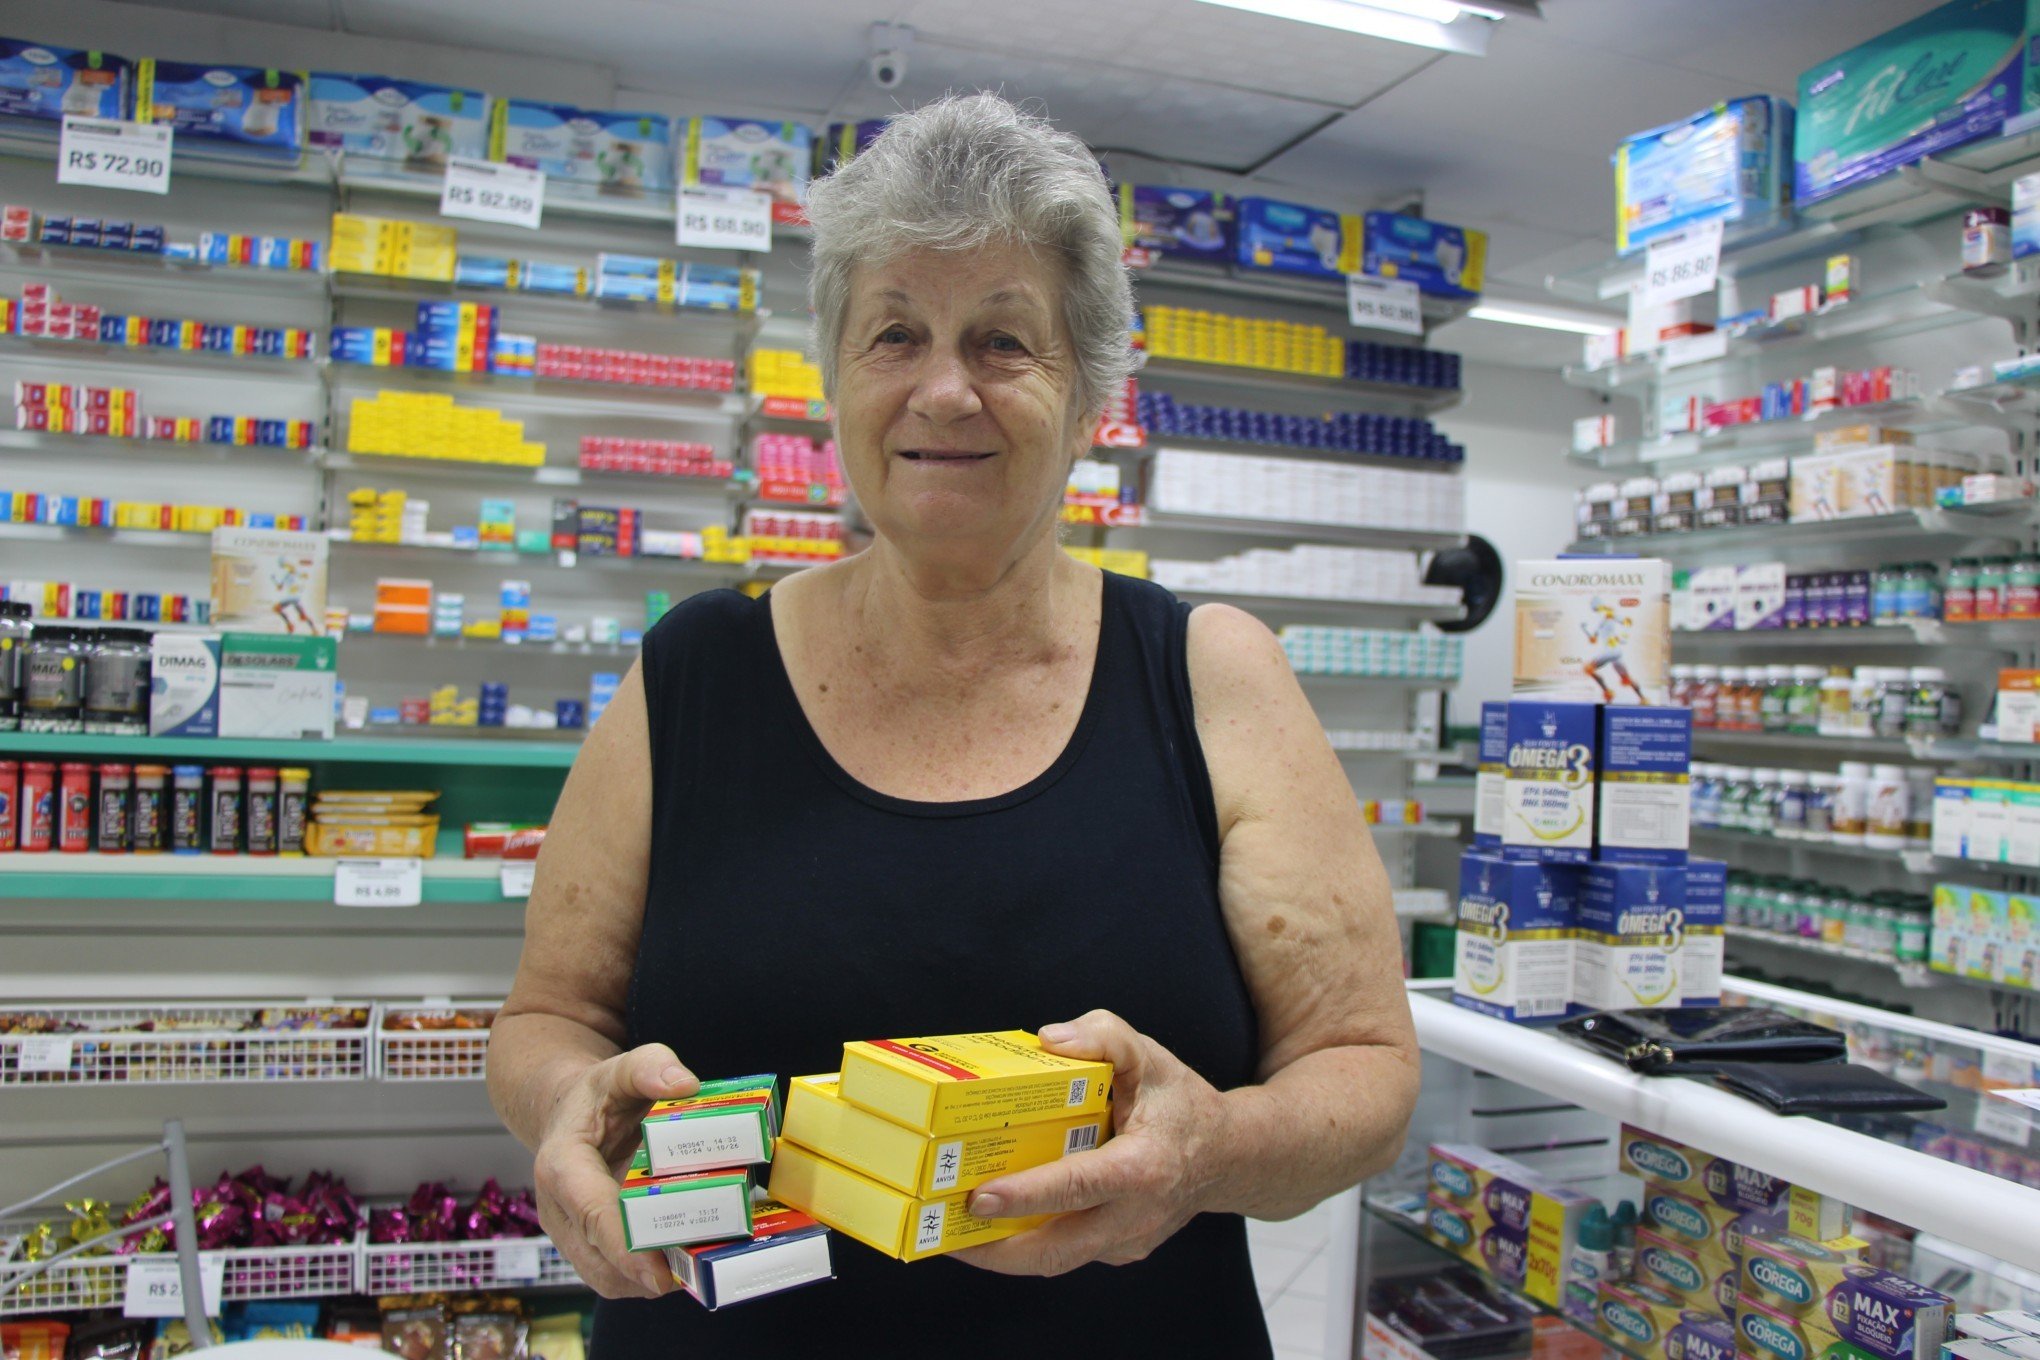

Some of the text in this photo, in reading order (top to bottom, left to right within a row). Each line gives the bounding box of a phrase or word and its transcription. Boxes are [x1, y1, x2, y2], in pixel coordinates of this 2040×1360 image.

[70, 151, 163, 177] R$ 72,90
[450, 187, 472, 204] R$
[1531, 574, 1645, 587] CONDROMAXX
[1562, 744, 1591, 790] 3
[1490, 902, 1510, 947] 3
[1660, 908, 1685, 954] 3
[1633, 1149, 1682, 1178] COREGA
[936, 1174, 955, 1183] ANVISA
[1435, 1167, 1467, 1193] COREGA
[1734, 1164, 1773, 1192] MAX
[1501, 1191, 1525, 1211] MAX
[1433, 1212, 1464, 1239] COREGA
[1656, 1204, 1701, 1233] COREGA
[919, 1235, 939, 1245] ANVISA
[1499, 1238, 1522, 1259] MAX
[1650, 1254, 1694, 1286] COREGA
[1754, 1266, 1803, 1299] COREGA
[149, 1283, 166, 1297] R$
[1883, 1277, 1933, 1296] MAX
[1606, 1306, 1648, 1339] COREGA
[1854, 1292, 1900, 1329] MAX
[1686, 1333, 1723, 1360] MAX
[1747, 1322, 1796, 1357] COREGA
[1857, 1323, 1892, 1344] BLOQUEIO
